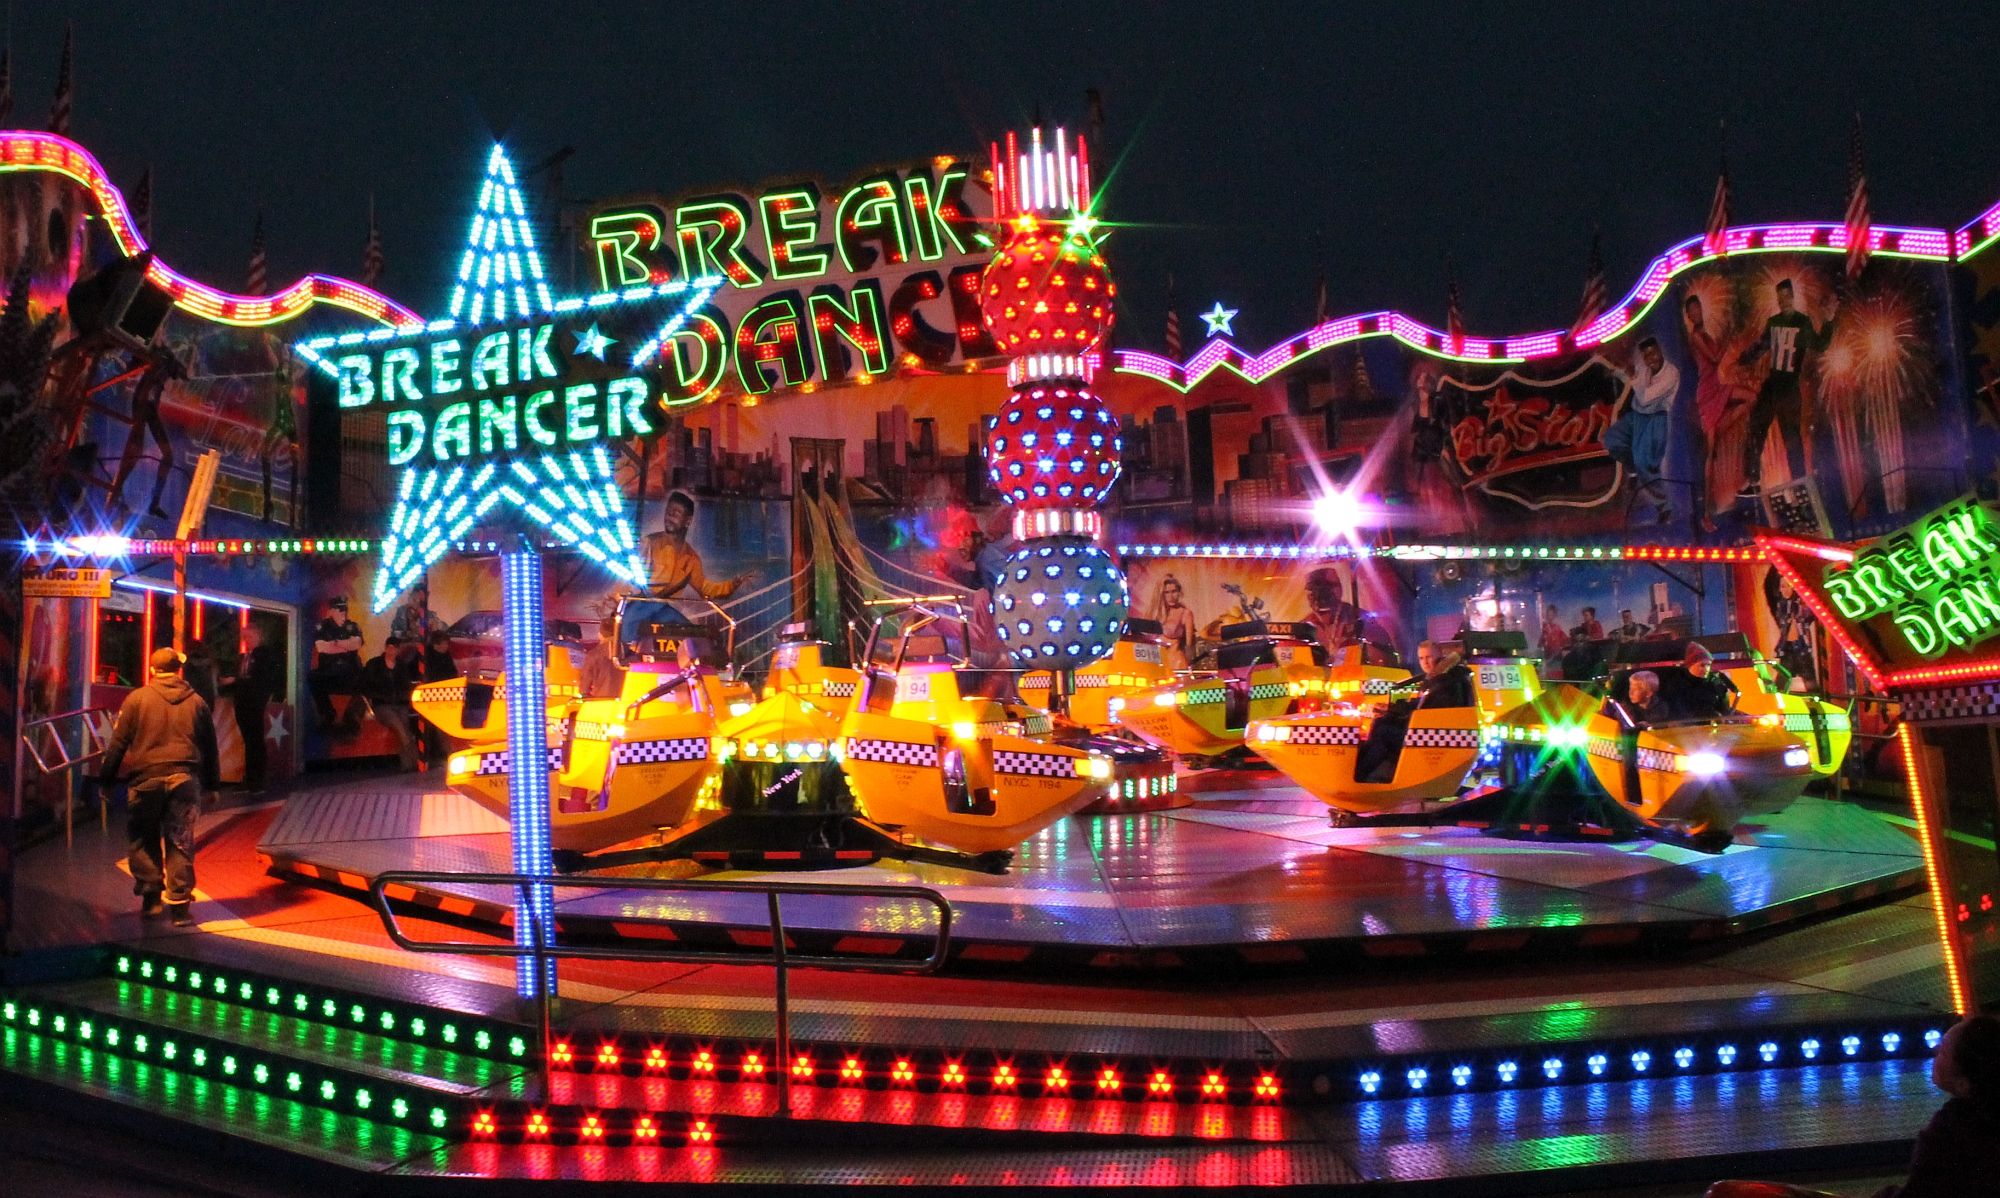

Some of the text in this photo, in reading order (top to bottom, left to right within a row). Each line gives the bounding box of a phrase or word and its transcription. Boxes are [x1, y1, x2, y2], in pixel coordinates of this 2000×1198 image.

[591, 171, 980, 292] BREAK
[338, 324, 558, 409] BREAK
[387, 376, 653, 465] DANCER
[1450, 400, 1613, 476] Big Star
[1822, 505, 1998, 621] BREAK
[1265, 622, 1292, 635] TAXI
[1893, 568, 2000, 657] DAN
[910, 682, 927, 695] 94
[1480, 672, 1519, 684] BD 94
[762, 768, 803, 798] New York
